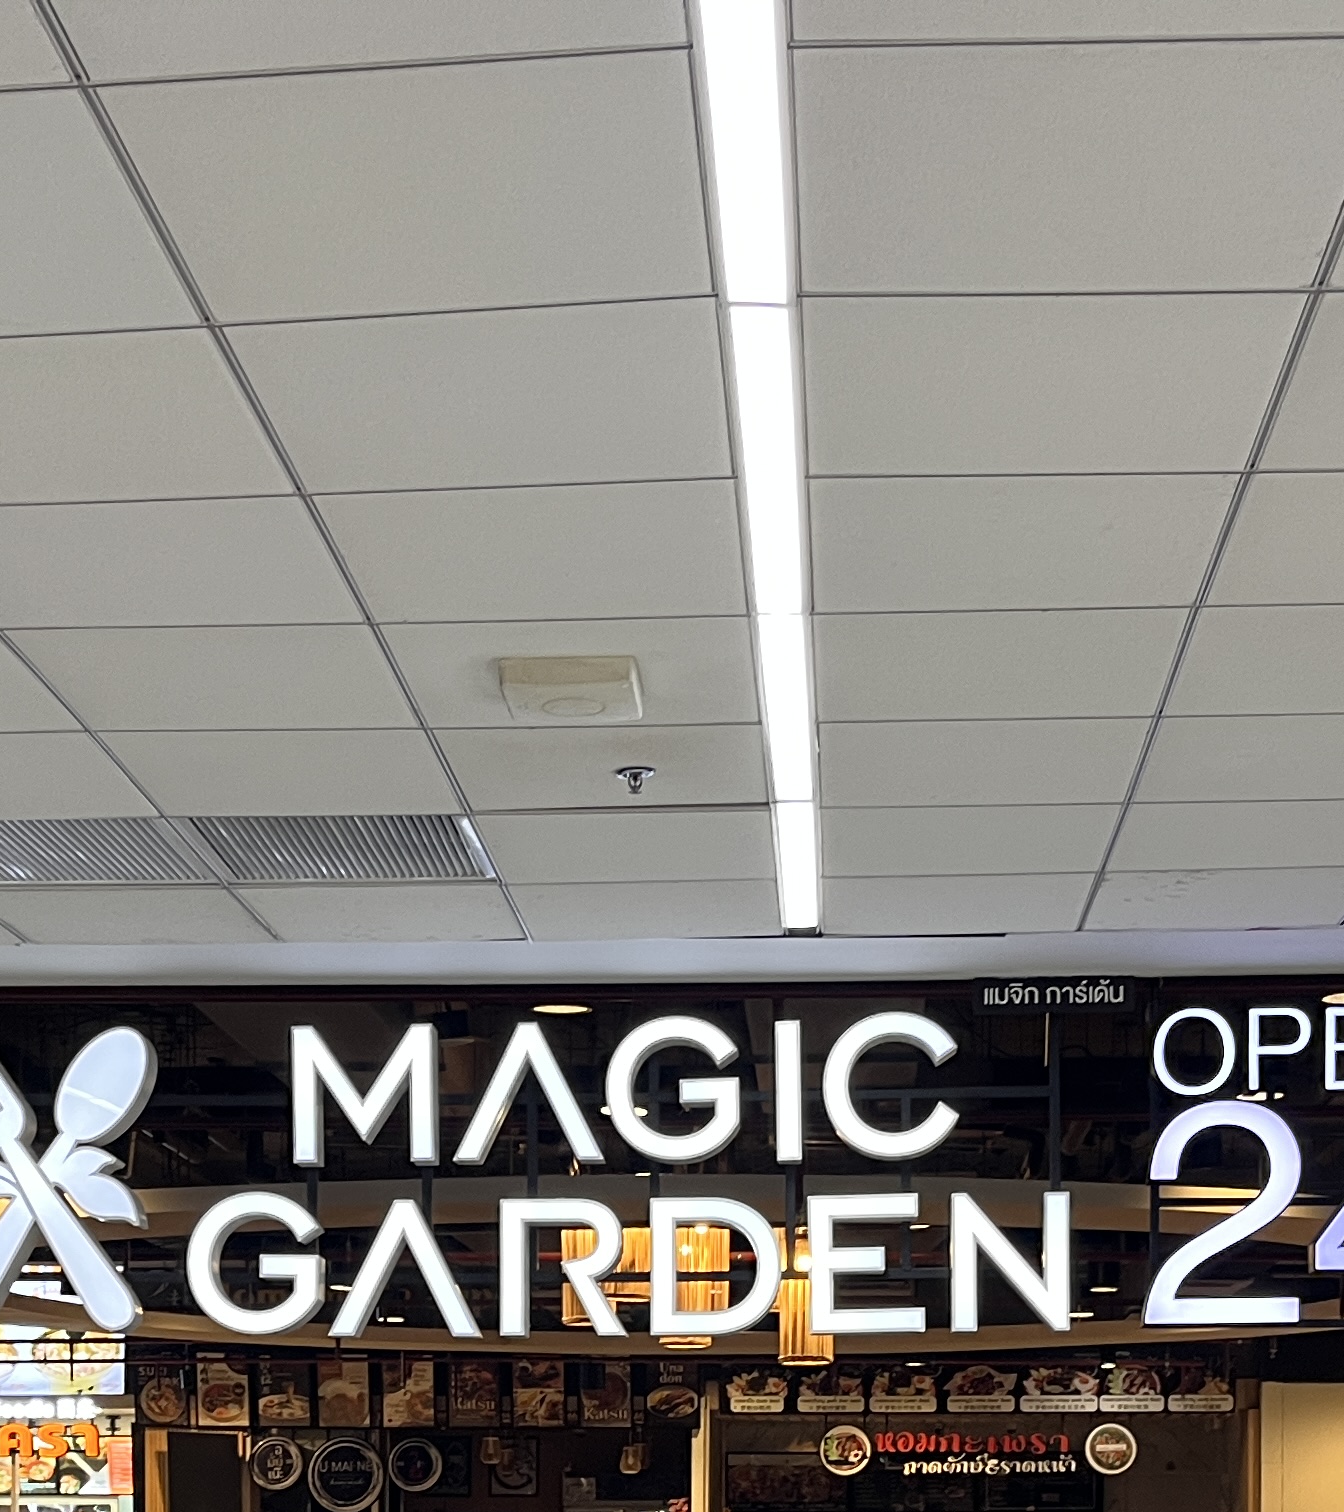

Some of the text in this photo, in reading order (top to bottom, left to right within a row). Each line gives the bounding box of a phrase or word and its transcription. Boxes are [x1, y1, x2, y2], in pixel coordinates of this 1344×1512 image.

[983, 979, 1125, 1005] แมจิก การ์เด้น
[289, 1010, 960, 1168] MAGIC
[186, 1190, 1071, 1338] GARDEN
